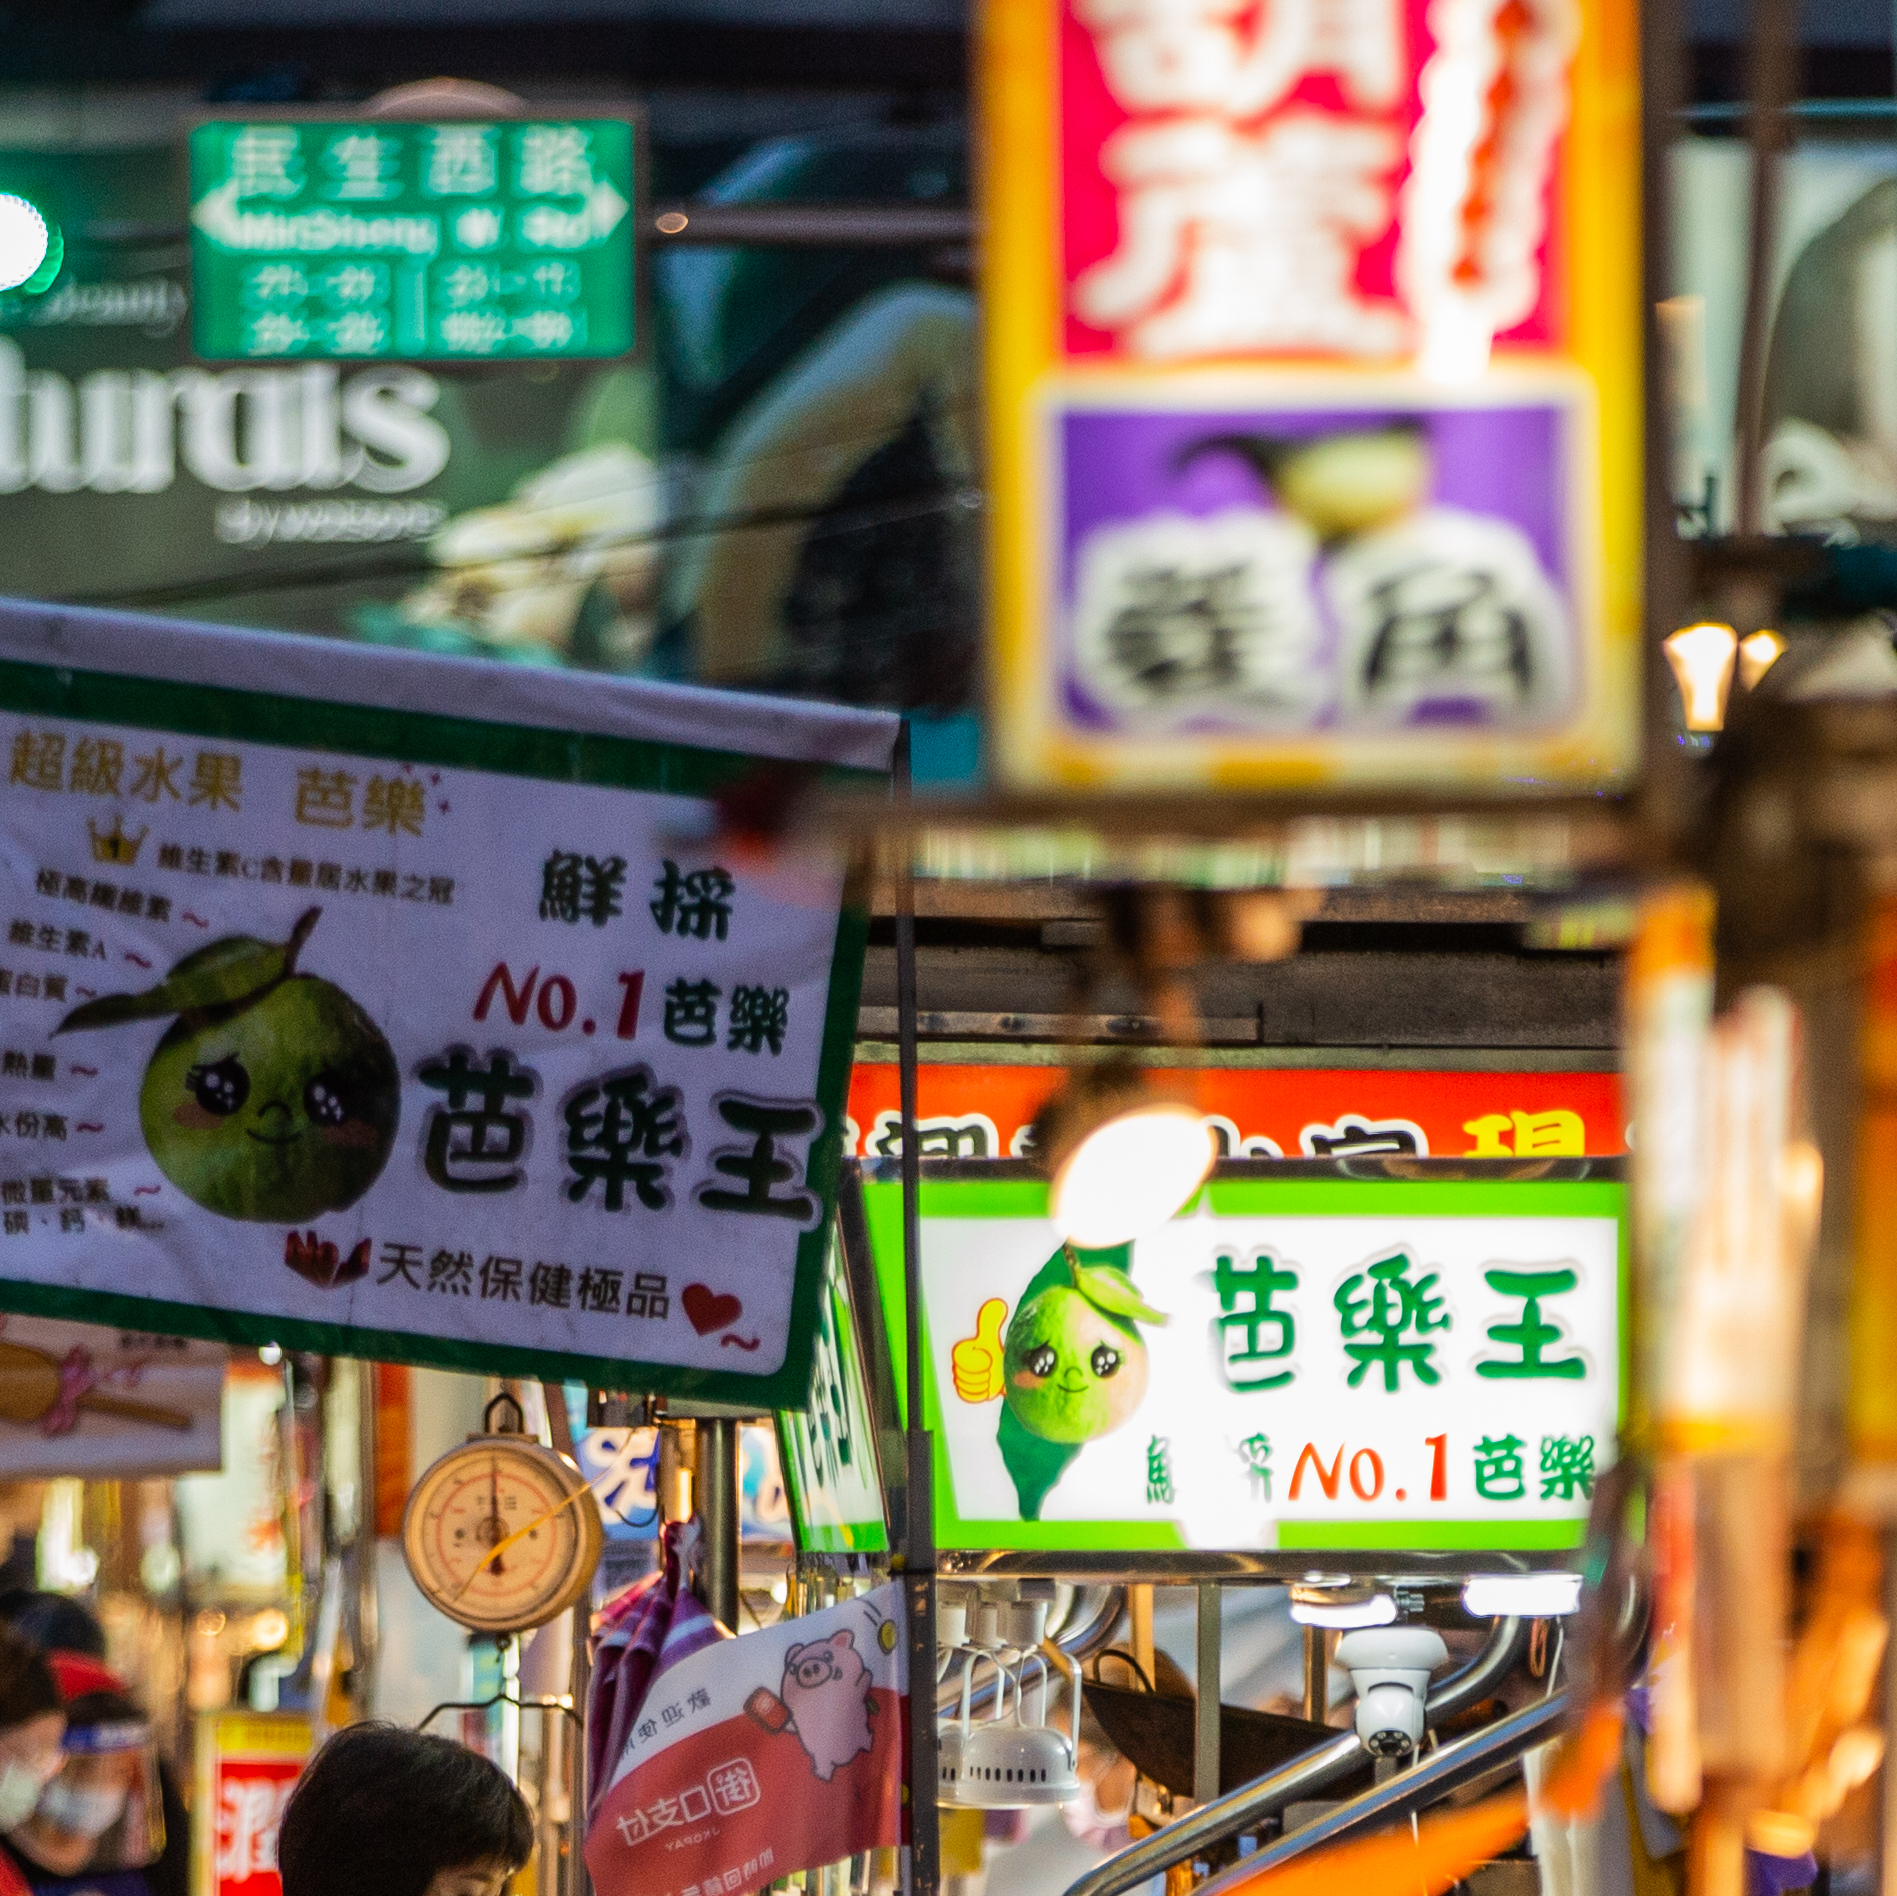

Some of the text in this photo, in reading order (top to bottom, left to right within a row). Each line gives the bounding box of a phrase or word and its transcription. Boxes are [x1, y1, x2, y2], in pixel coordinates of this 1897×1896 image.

[230, 124, 595, 200] 民生西路
[9, 729, 428, 838] 超級水果 芭樂
[538, 848, 737, 942] 鮮採
[472, 960, 791, 1057] No.1 芭樂
[414, 1046, 820, 1226] 芭樂王
[376, 1241, 670, 1321] 天然保健極品
[1215, 1251, 1587, 1393] 芭樂王
[1288, 1433, 1447, 1502] No.1
[1474, 1435, 1597, 1502] 芭樂
